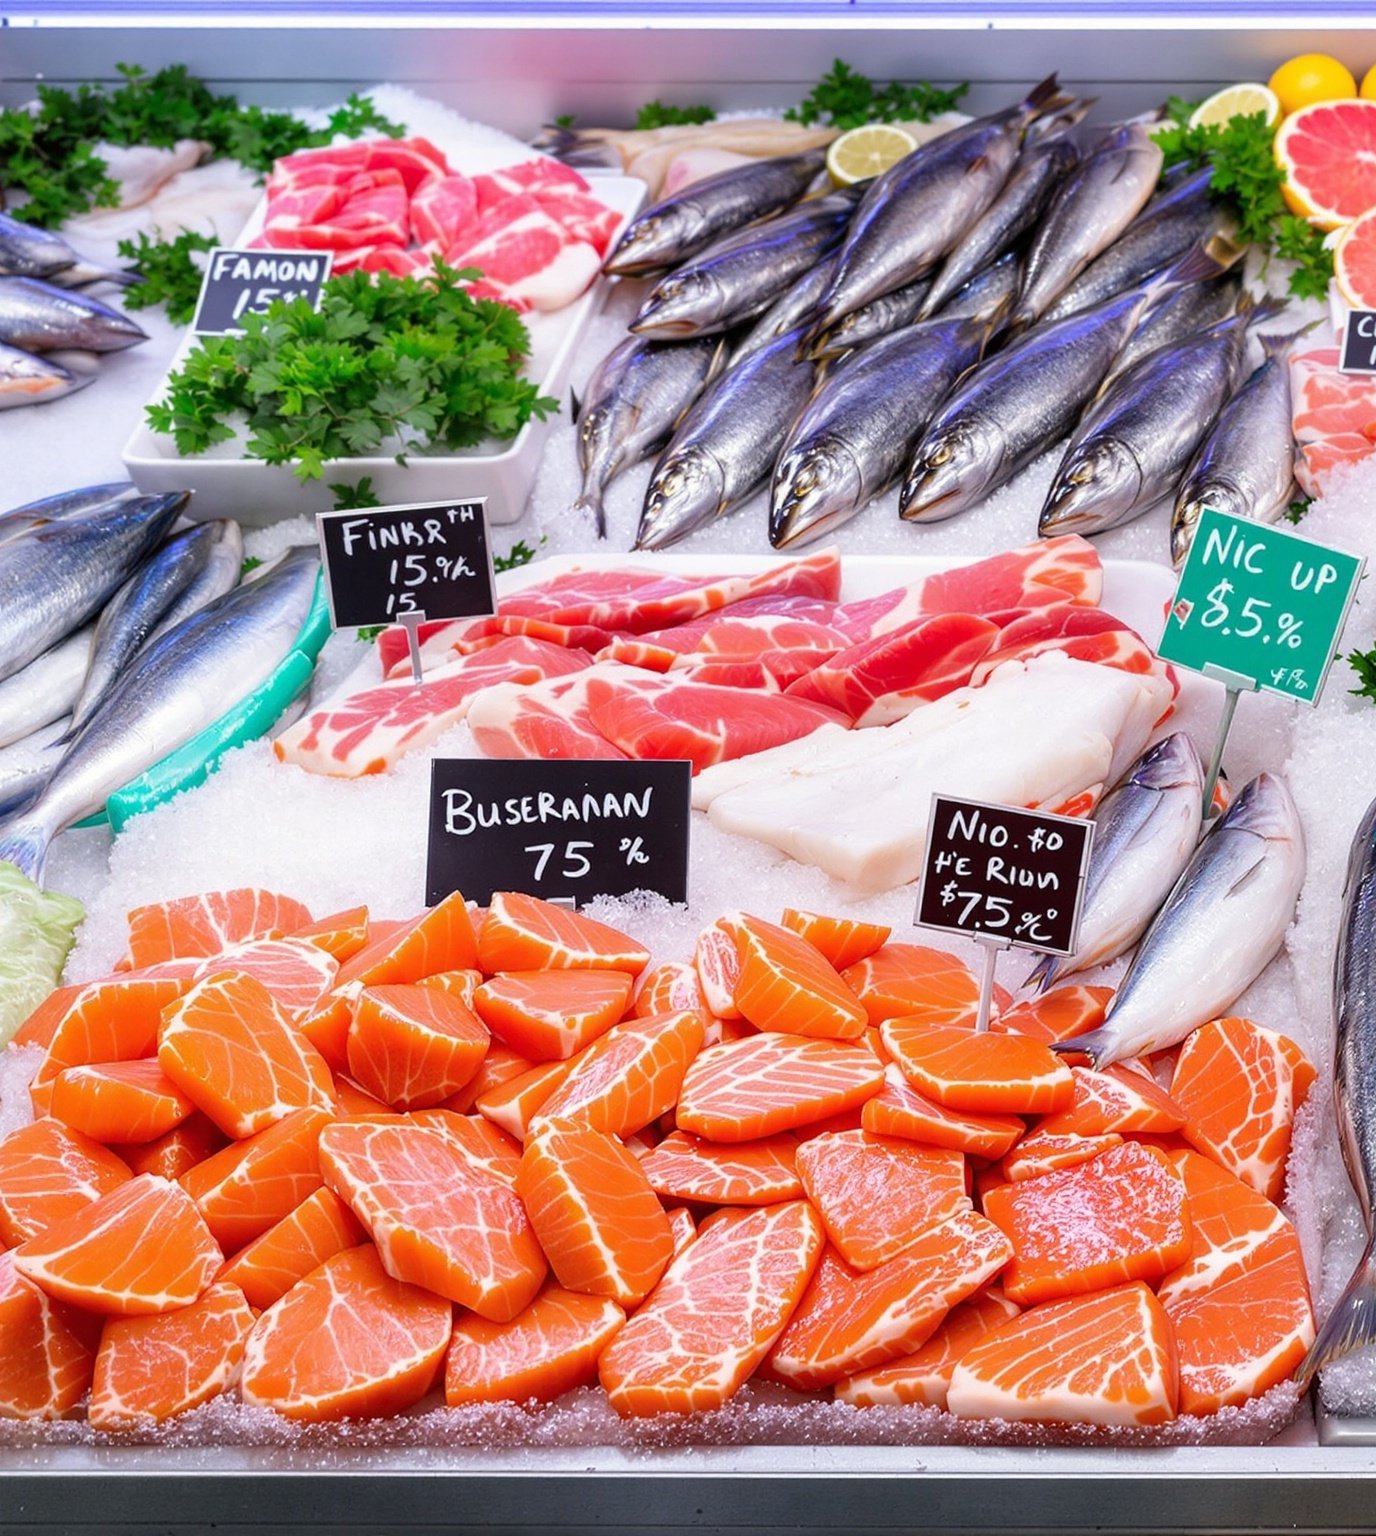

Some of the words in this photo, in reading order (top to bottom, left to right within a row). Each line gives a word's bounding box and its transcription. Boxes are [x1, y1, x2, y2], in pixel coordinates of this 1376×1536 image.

[212, 253, 319, 283] FAMON
[1290, 561, 1338, 595] UP
[523, 840, 595, 881] 75
